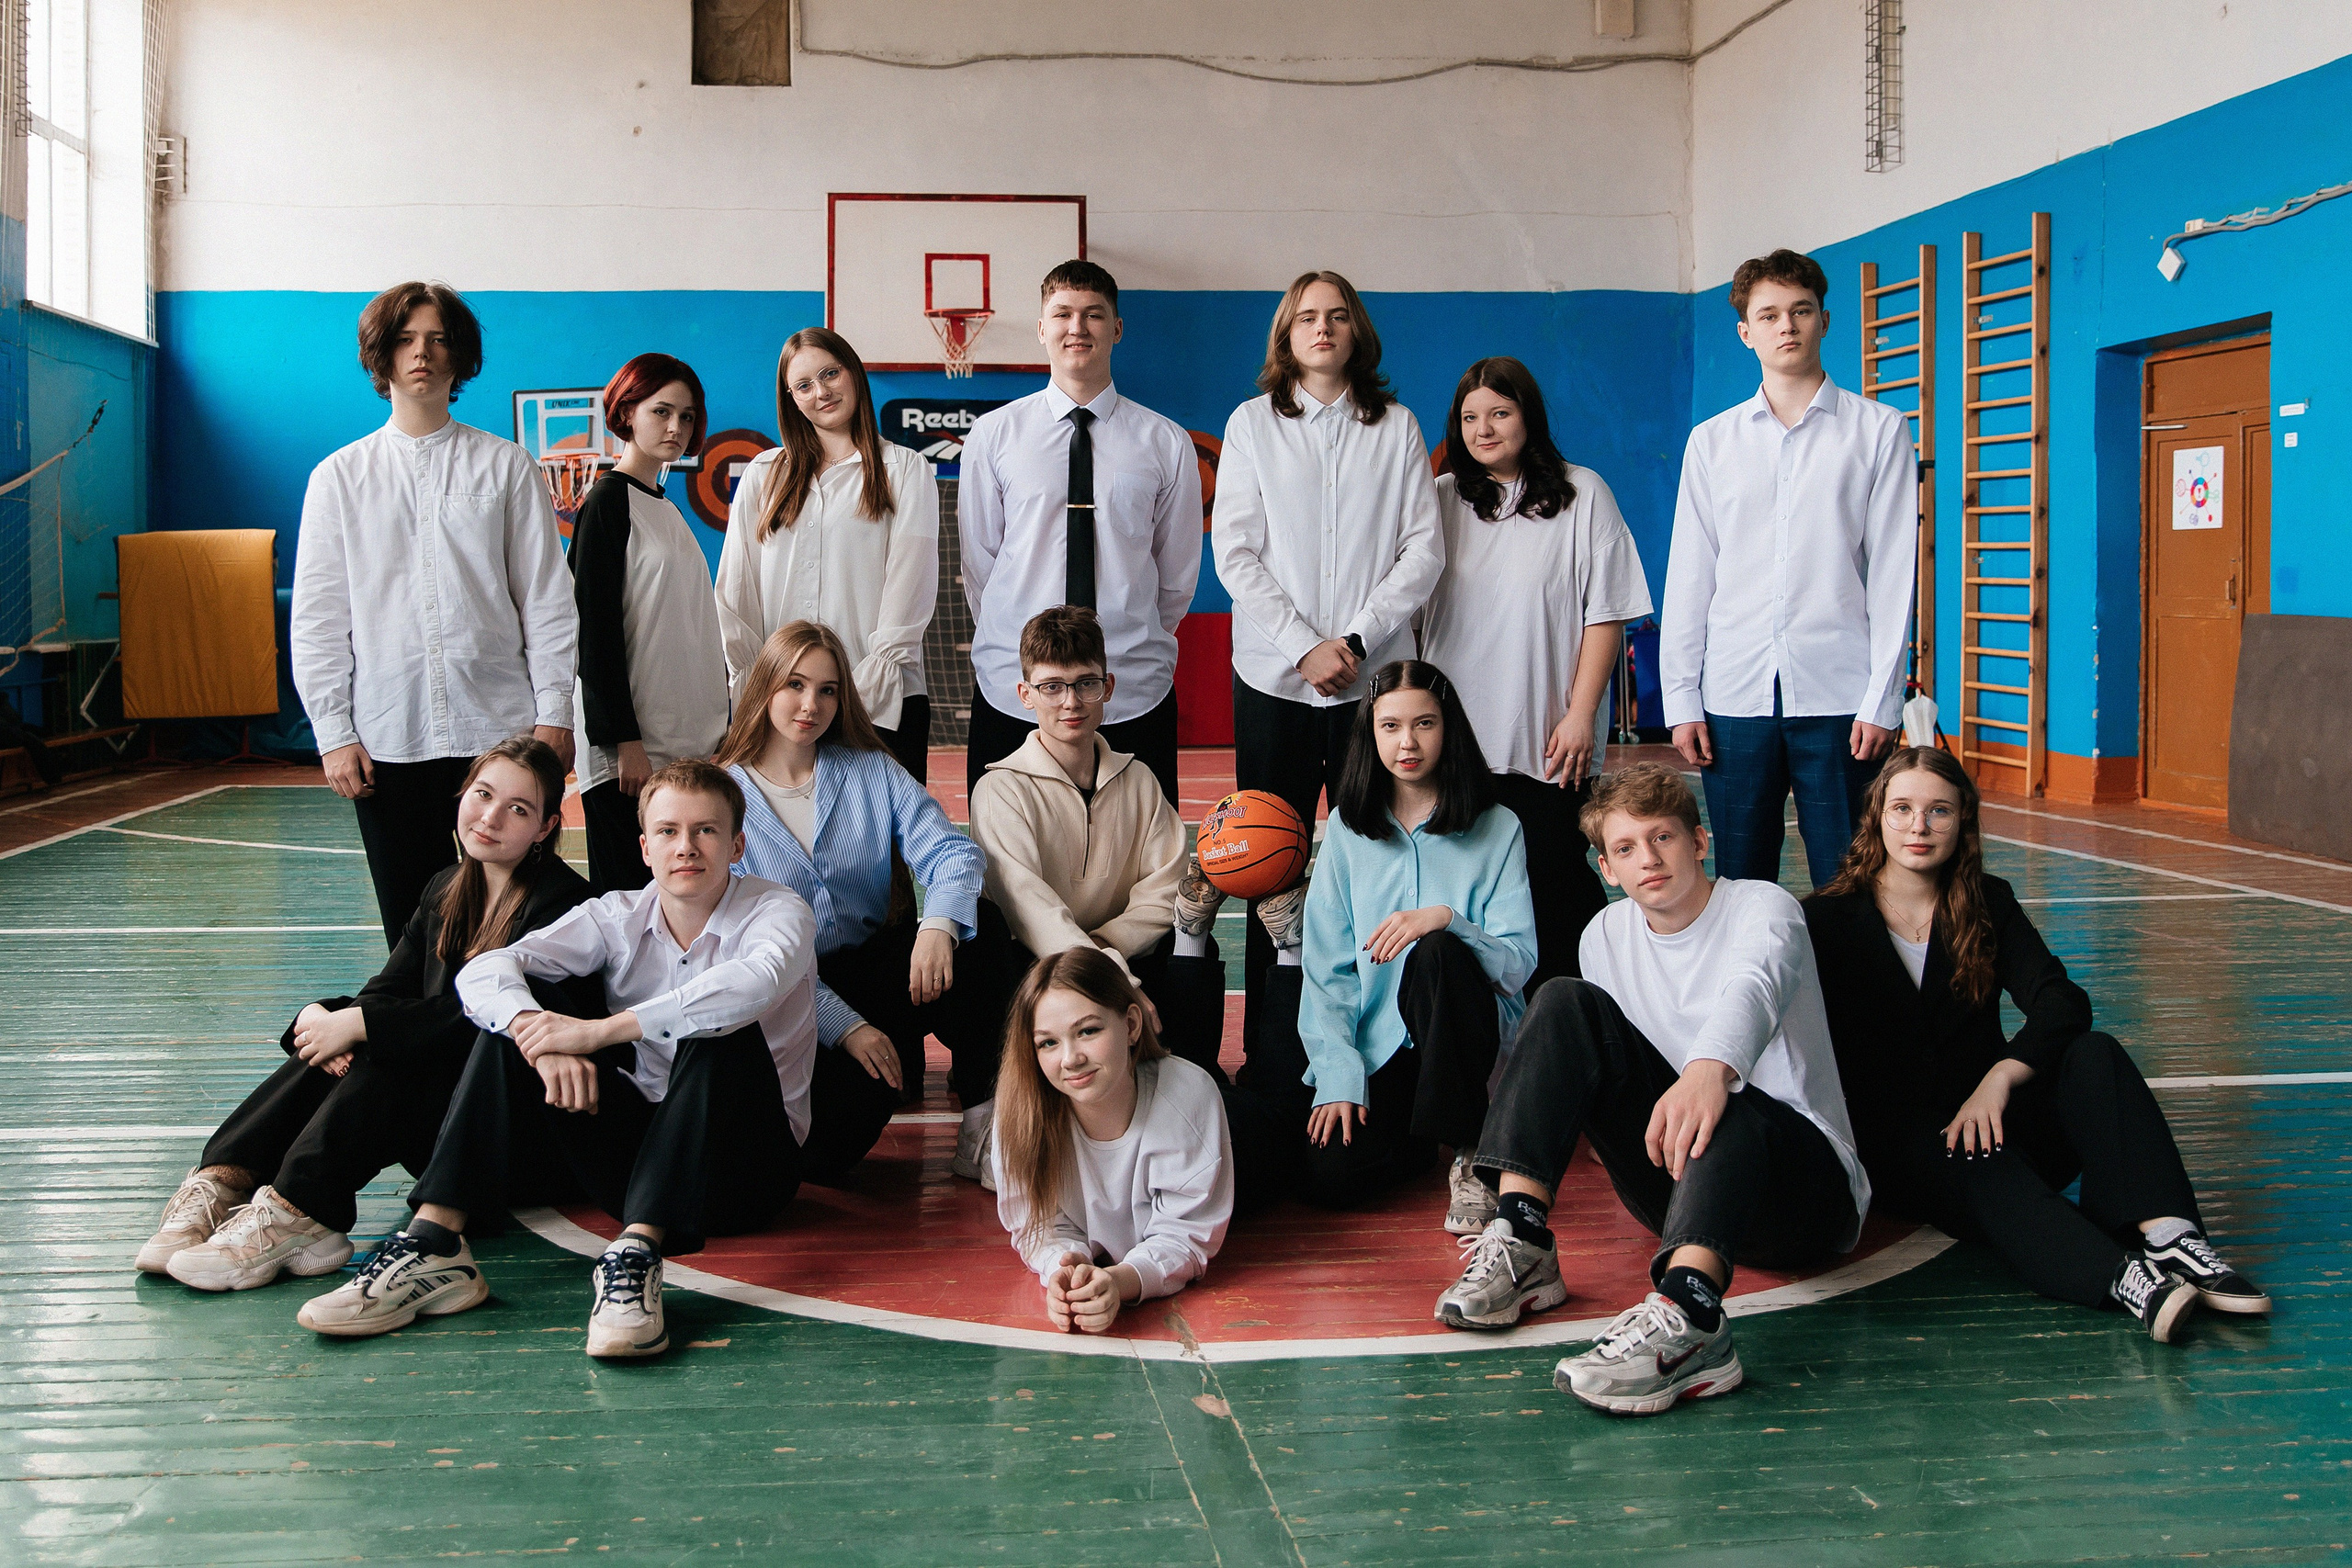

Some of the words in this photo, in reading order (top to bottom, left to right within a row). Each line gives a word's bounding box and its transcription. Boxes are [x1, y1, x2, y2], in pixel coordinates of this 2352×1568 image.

[901, 408, 977, 433] Reeb
[1202, 846, 1227, 861] Basket
[1227, 840, 1250, 855] Ball
